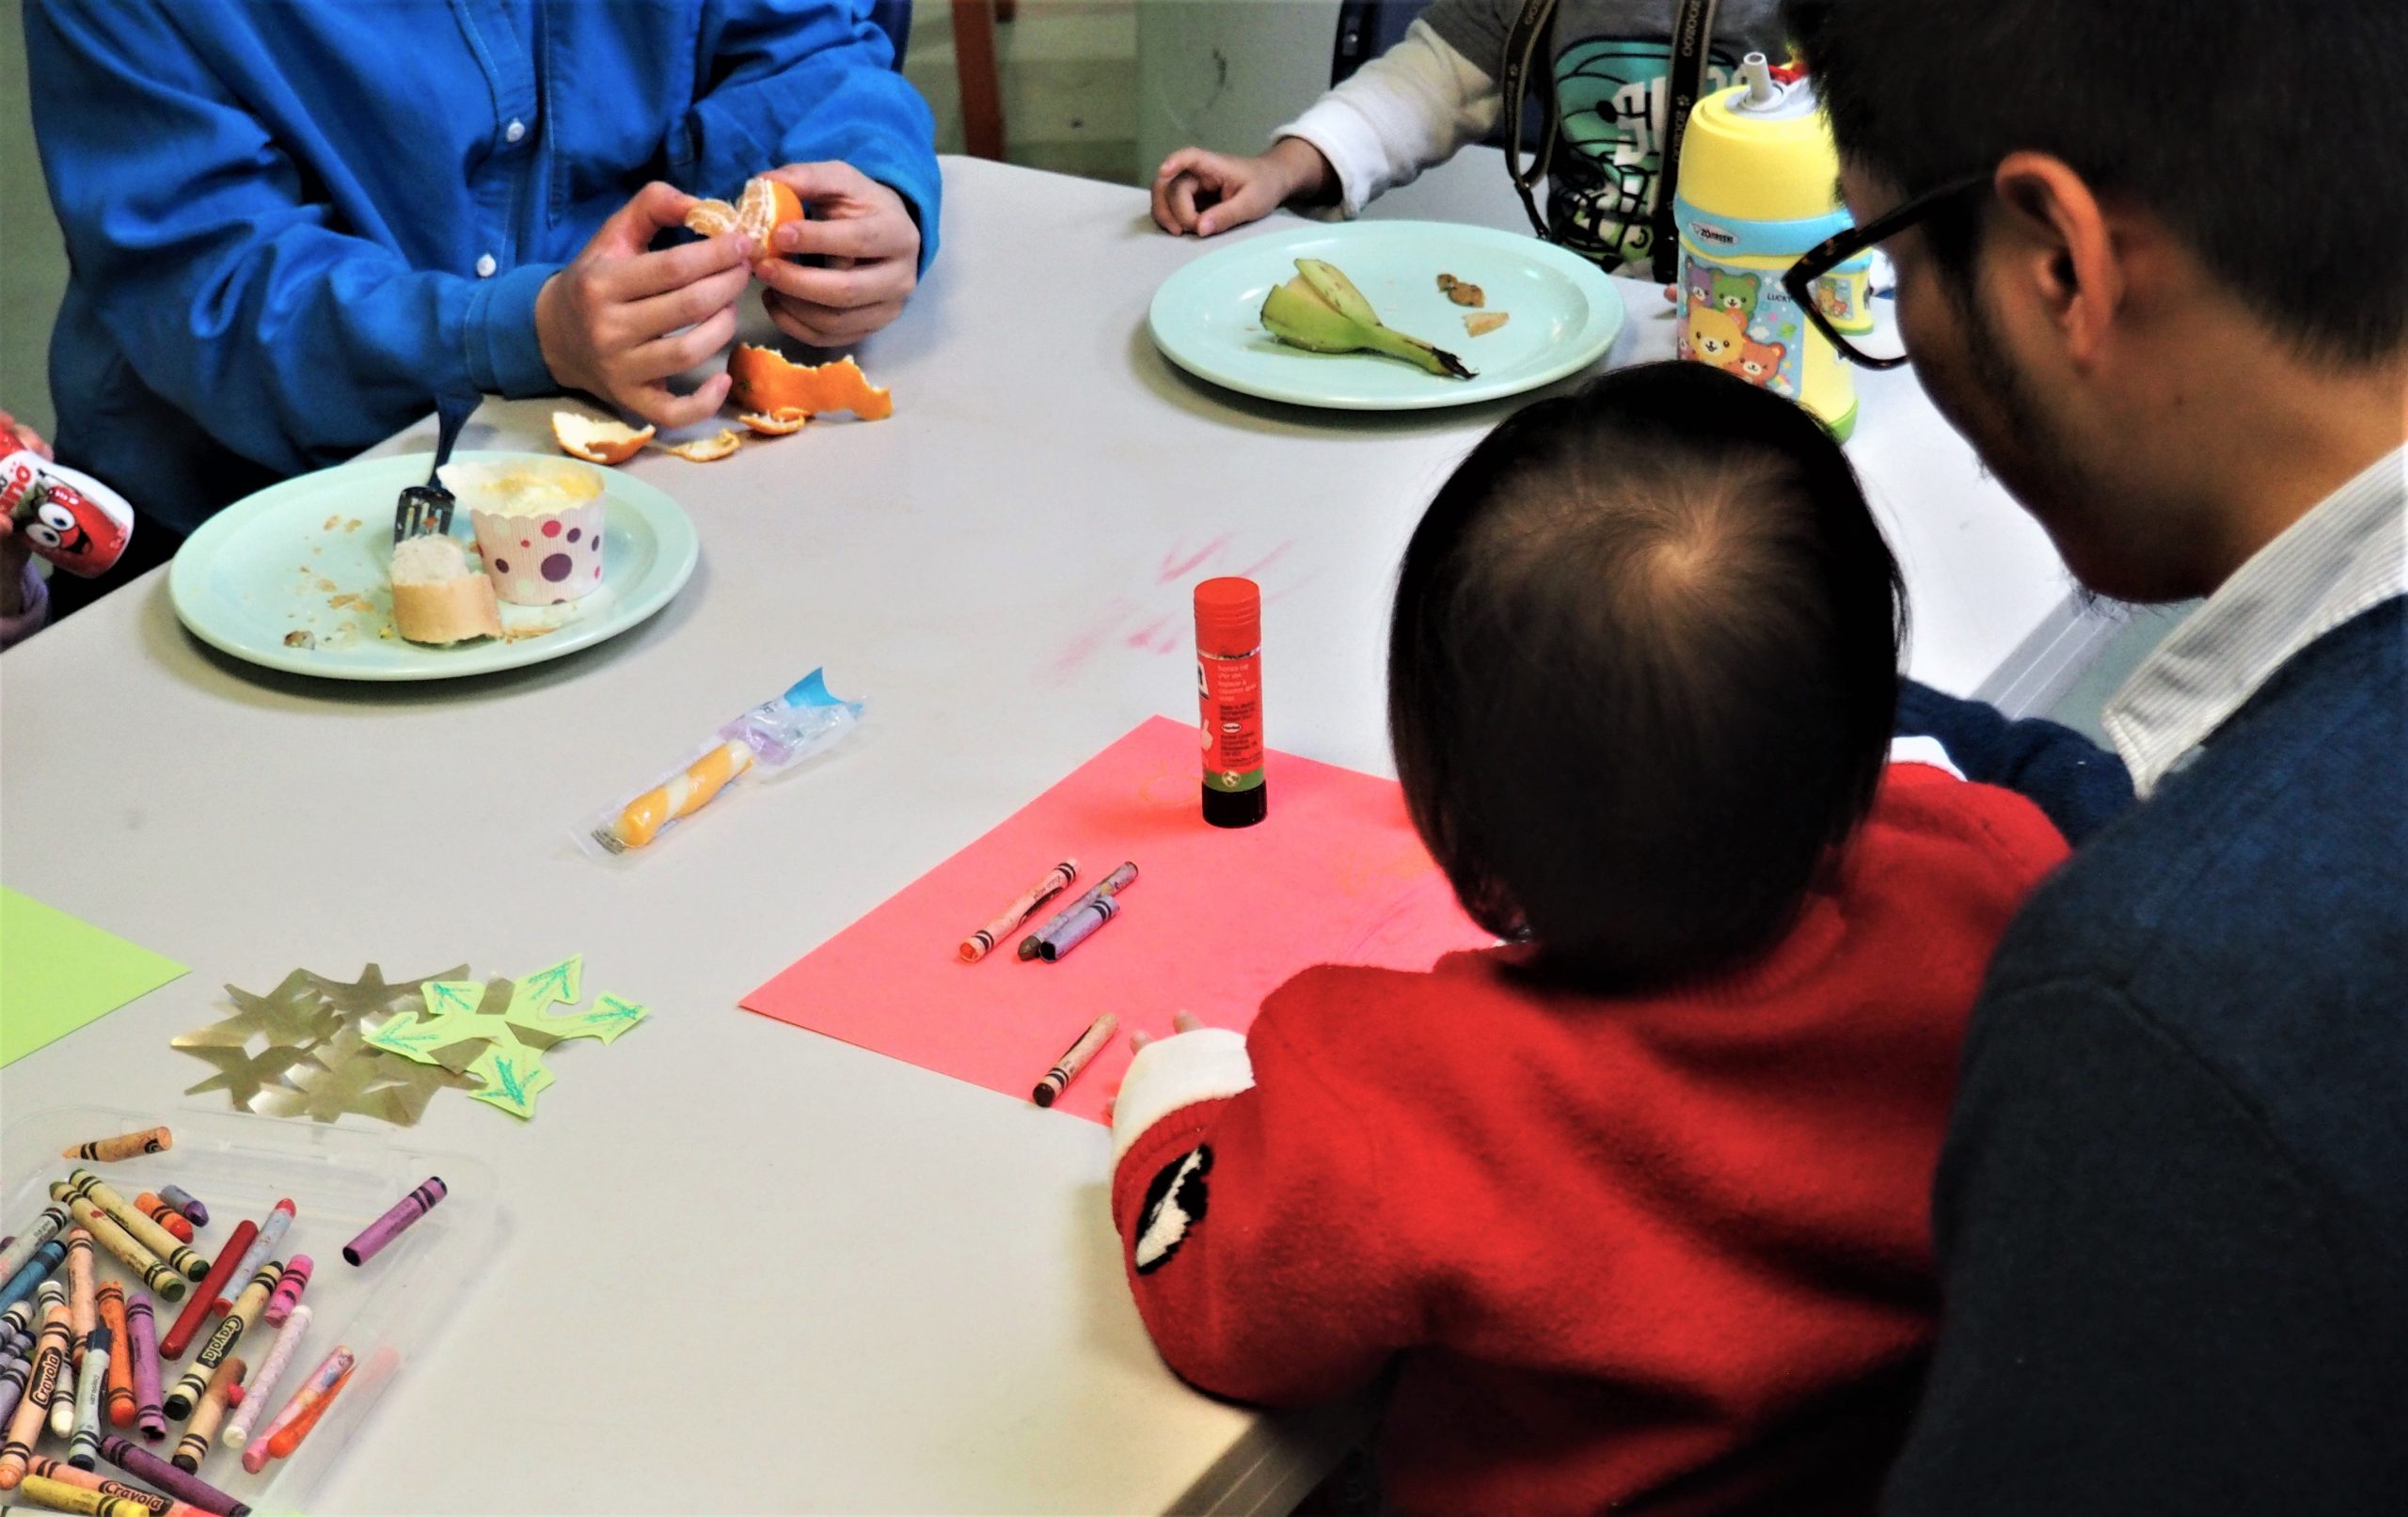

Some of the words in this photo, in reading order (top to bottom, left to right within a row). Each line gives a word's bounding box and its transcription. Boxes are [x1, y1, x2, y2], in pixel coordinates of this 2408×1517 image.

[202, 1318, 241, 1361] Crayola
[32, 1354, 60, 1405] Crayola
[103, 1481, 164, 1510] Crayola
